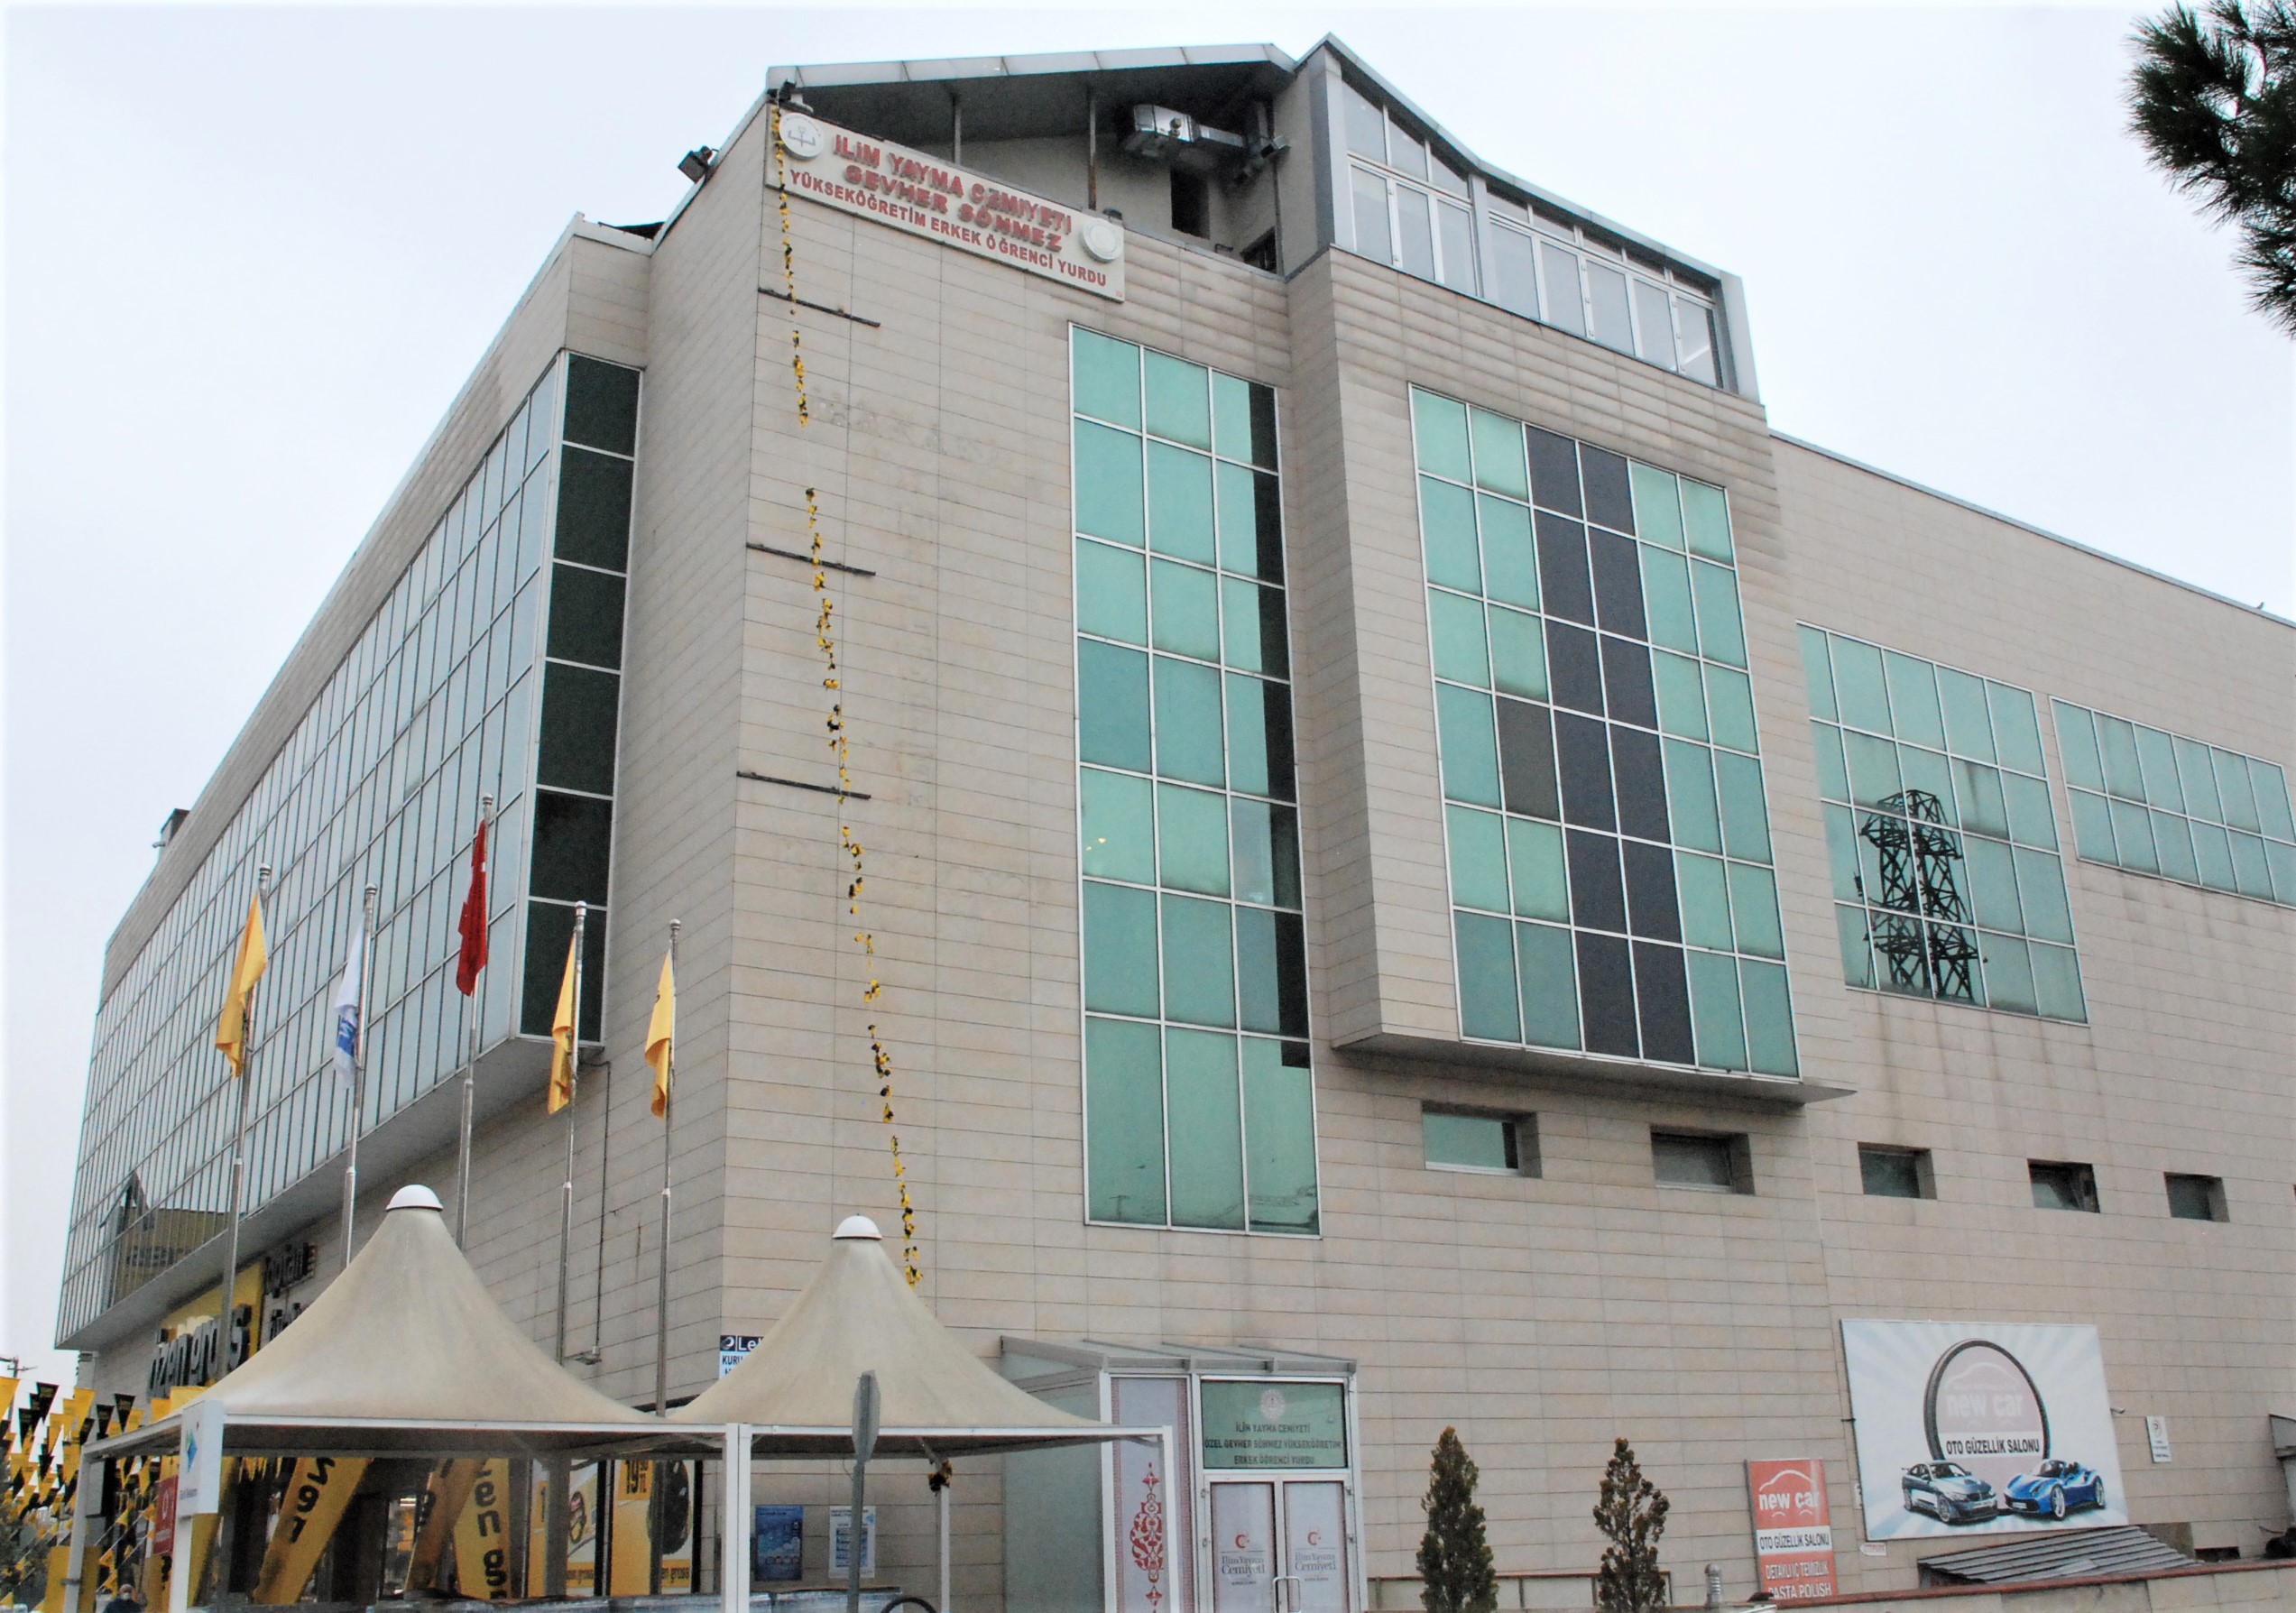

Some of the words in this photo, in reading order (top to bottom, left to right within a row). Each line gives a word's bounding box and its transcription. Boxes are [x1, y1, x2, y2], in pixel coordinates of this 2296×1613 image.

[888, 152, 964, 198] YAYMA
[845, 164, 948, 214] GEVHER
[958, 203, 1063, 253] SÖNMEZ
[790, 170, 927, 226] YÜKSEKÖĞRETİM
[931, 217, 982, 245] ERKEK
[1057, 259, 1106, 287] YURDU
[1947, 1394, 1986, 1417] new
[1994, 1394, 2023, 1417] car
[1253, 1424, 1277, 1433] YAYMA
[1946, 1441, 1963, 1454] OTO
[1965, 1437, 2006, 1454] GÜZELLİK
[2007, 1439, 2040, 1452] SALONU
[1234, 1455, 1258, 1464] ERKEK
[1759, 1491, 1790, 1510] new
[1795, 1490, 1820, 1509] car
[1760, 1536, 1773, 1550] OTO
[1804, 1534, 1830, 1546] SALONU
[1222, 1564, 1265, 1577] Cemiyeti
[1295, 1562, 1336, 1573] Cemiyeti
